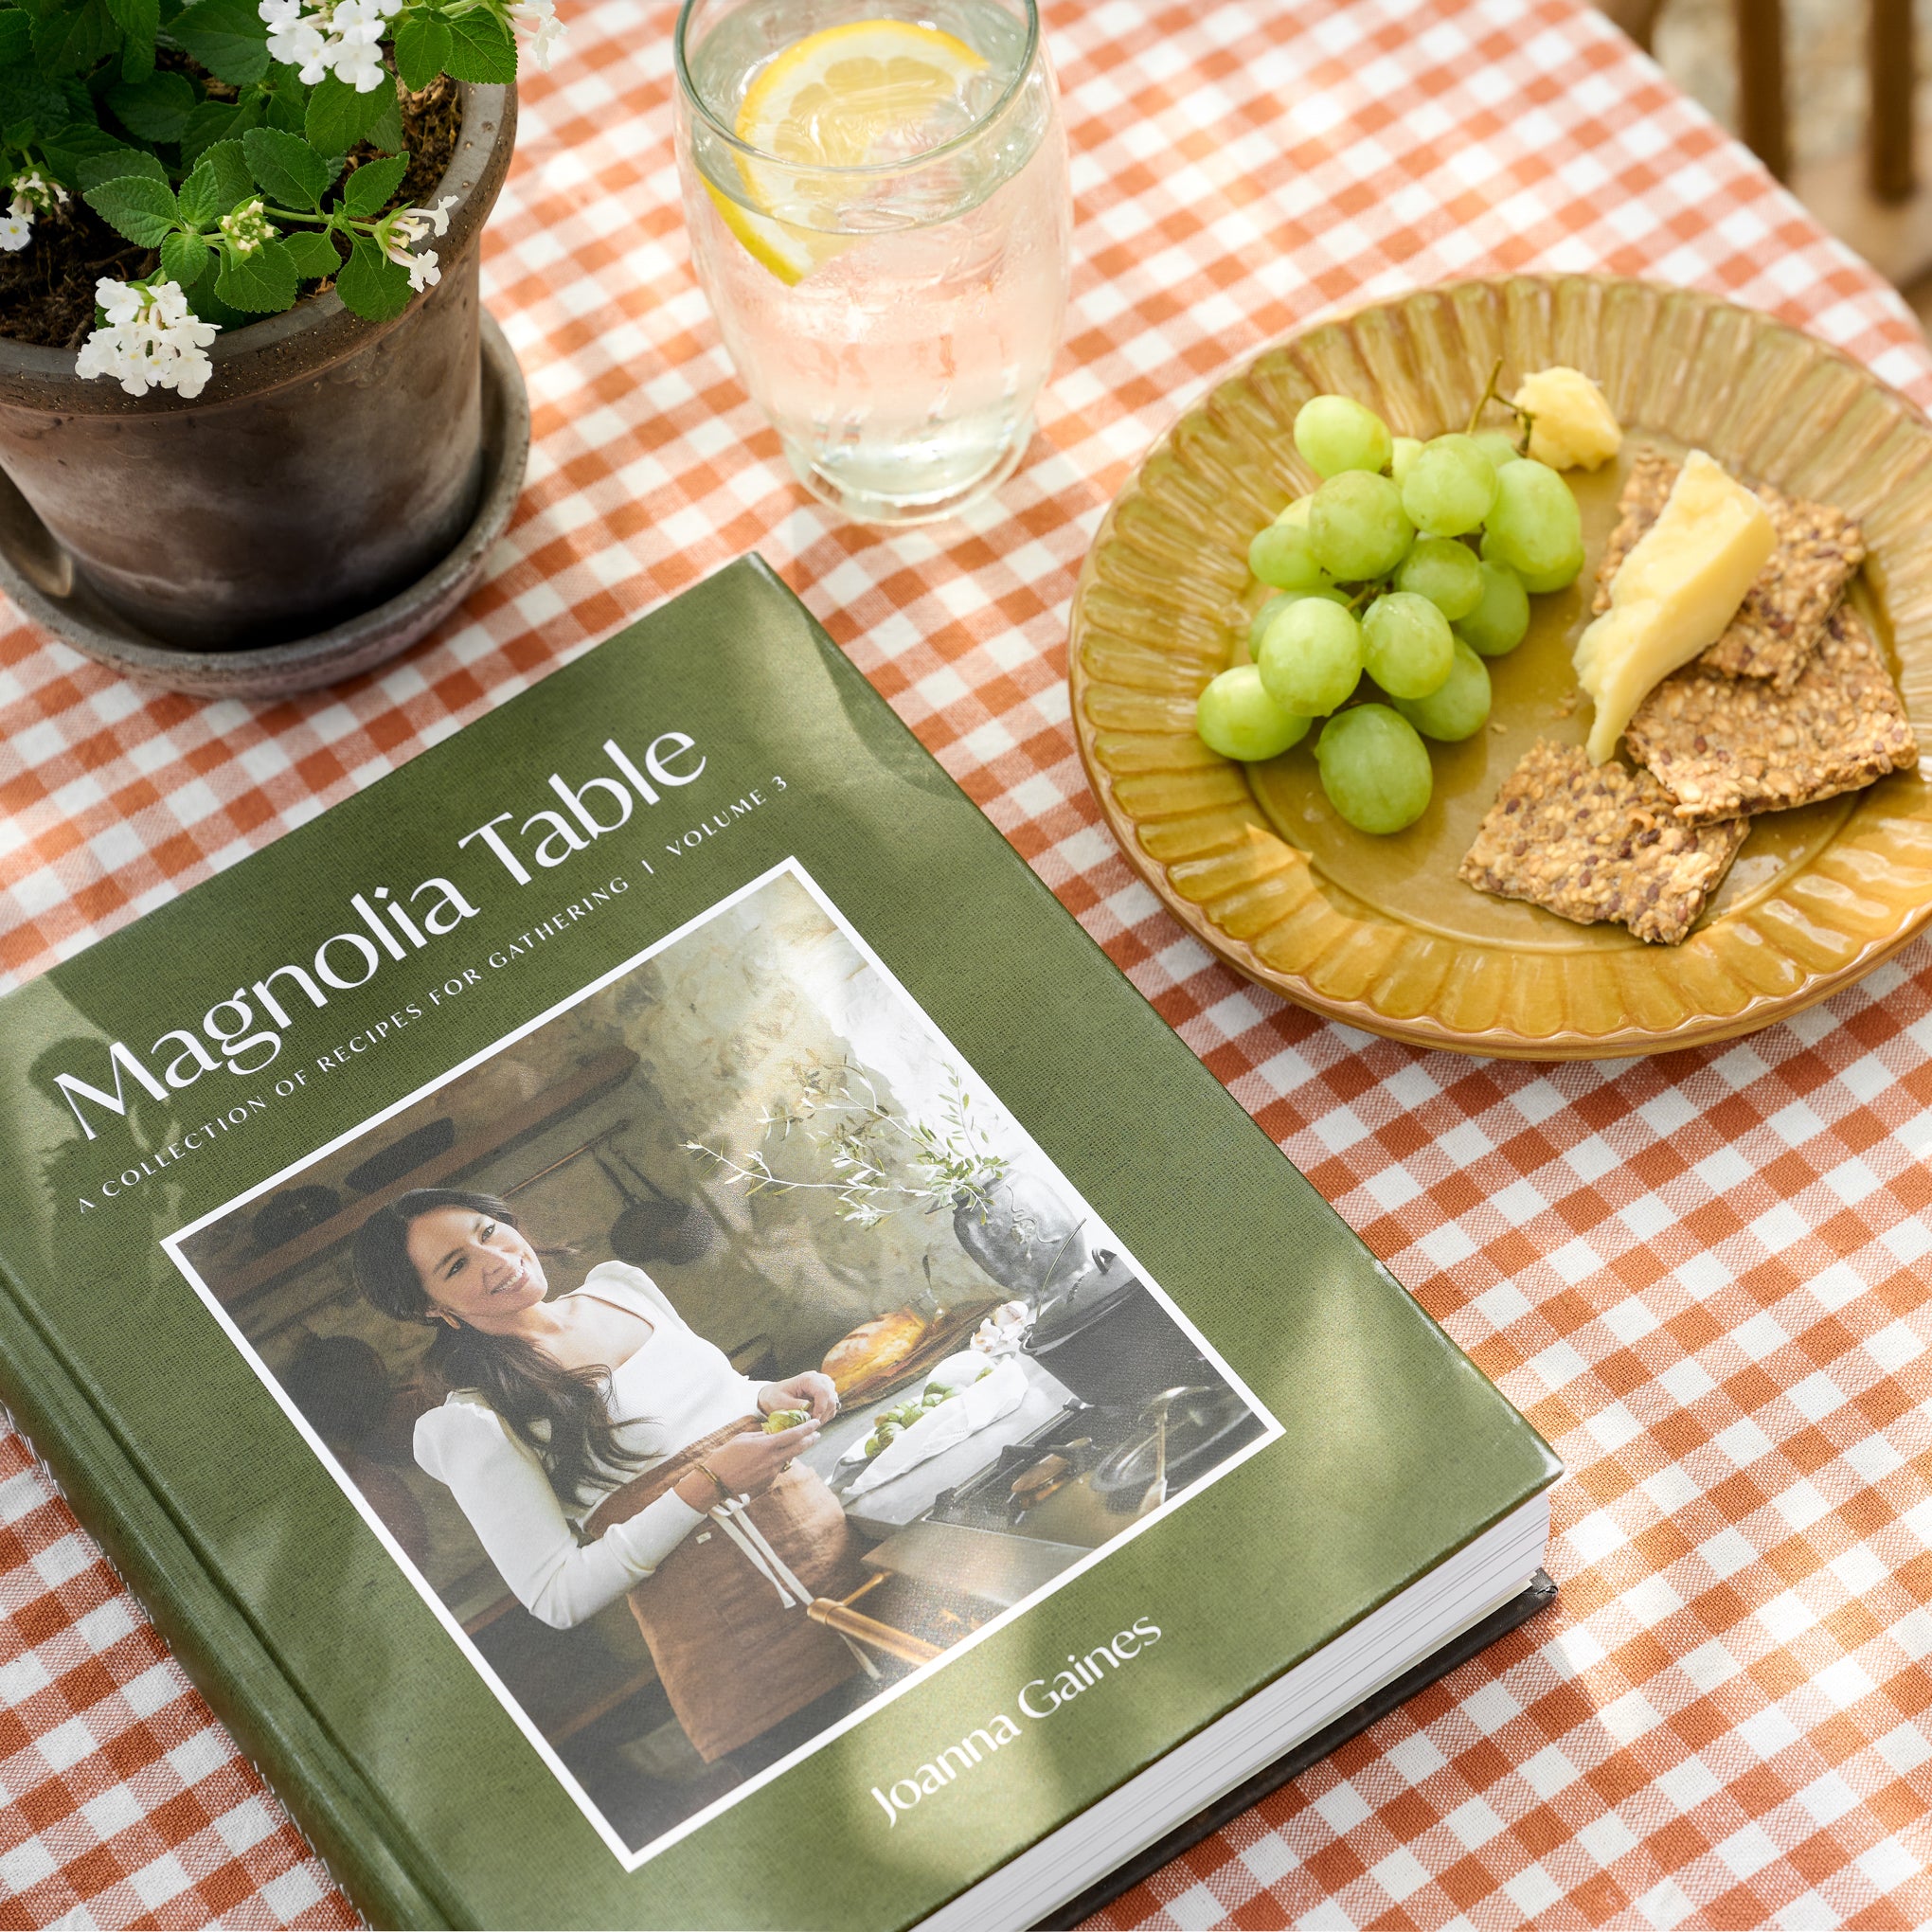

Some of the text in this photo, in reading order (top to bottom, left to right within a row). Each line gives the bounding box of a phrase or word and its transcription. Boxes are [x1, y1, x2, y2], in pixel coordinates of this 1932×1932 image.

[53, 730, 707, 1141] Magnolia Table
[77, 1196, 96, 1213] A
[101, 1095, 266, 1197] COLLECTION
[275, 1069, 308, 1098] OF
[316, 1003, 422, 1072] RECIPES
[428, 968, 482, 1006] FOR
[488, 876, 630, 969] GATHERING
[665, 788, 767, 857] VOLUME
[771, 775, 788, 792] 3
[870, 1616, 1163, 1829] Joanna Gaines
